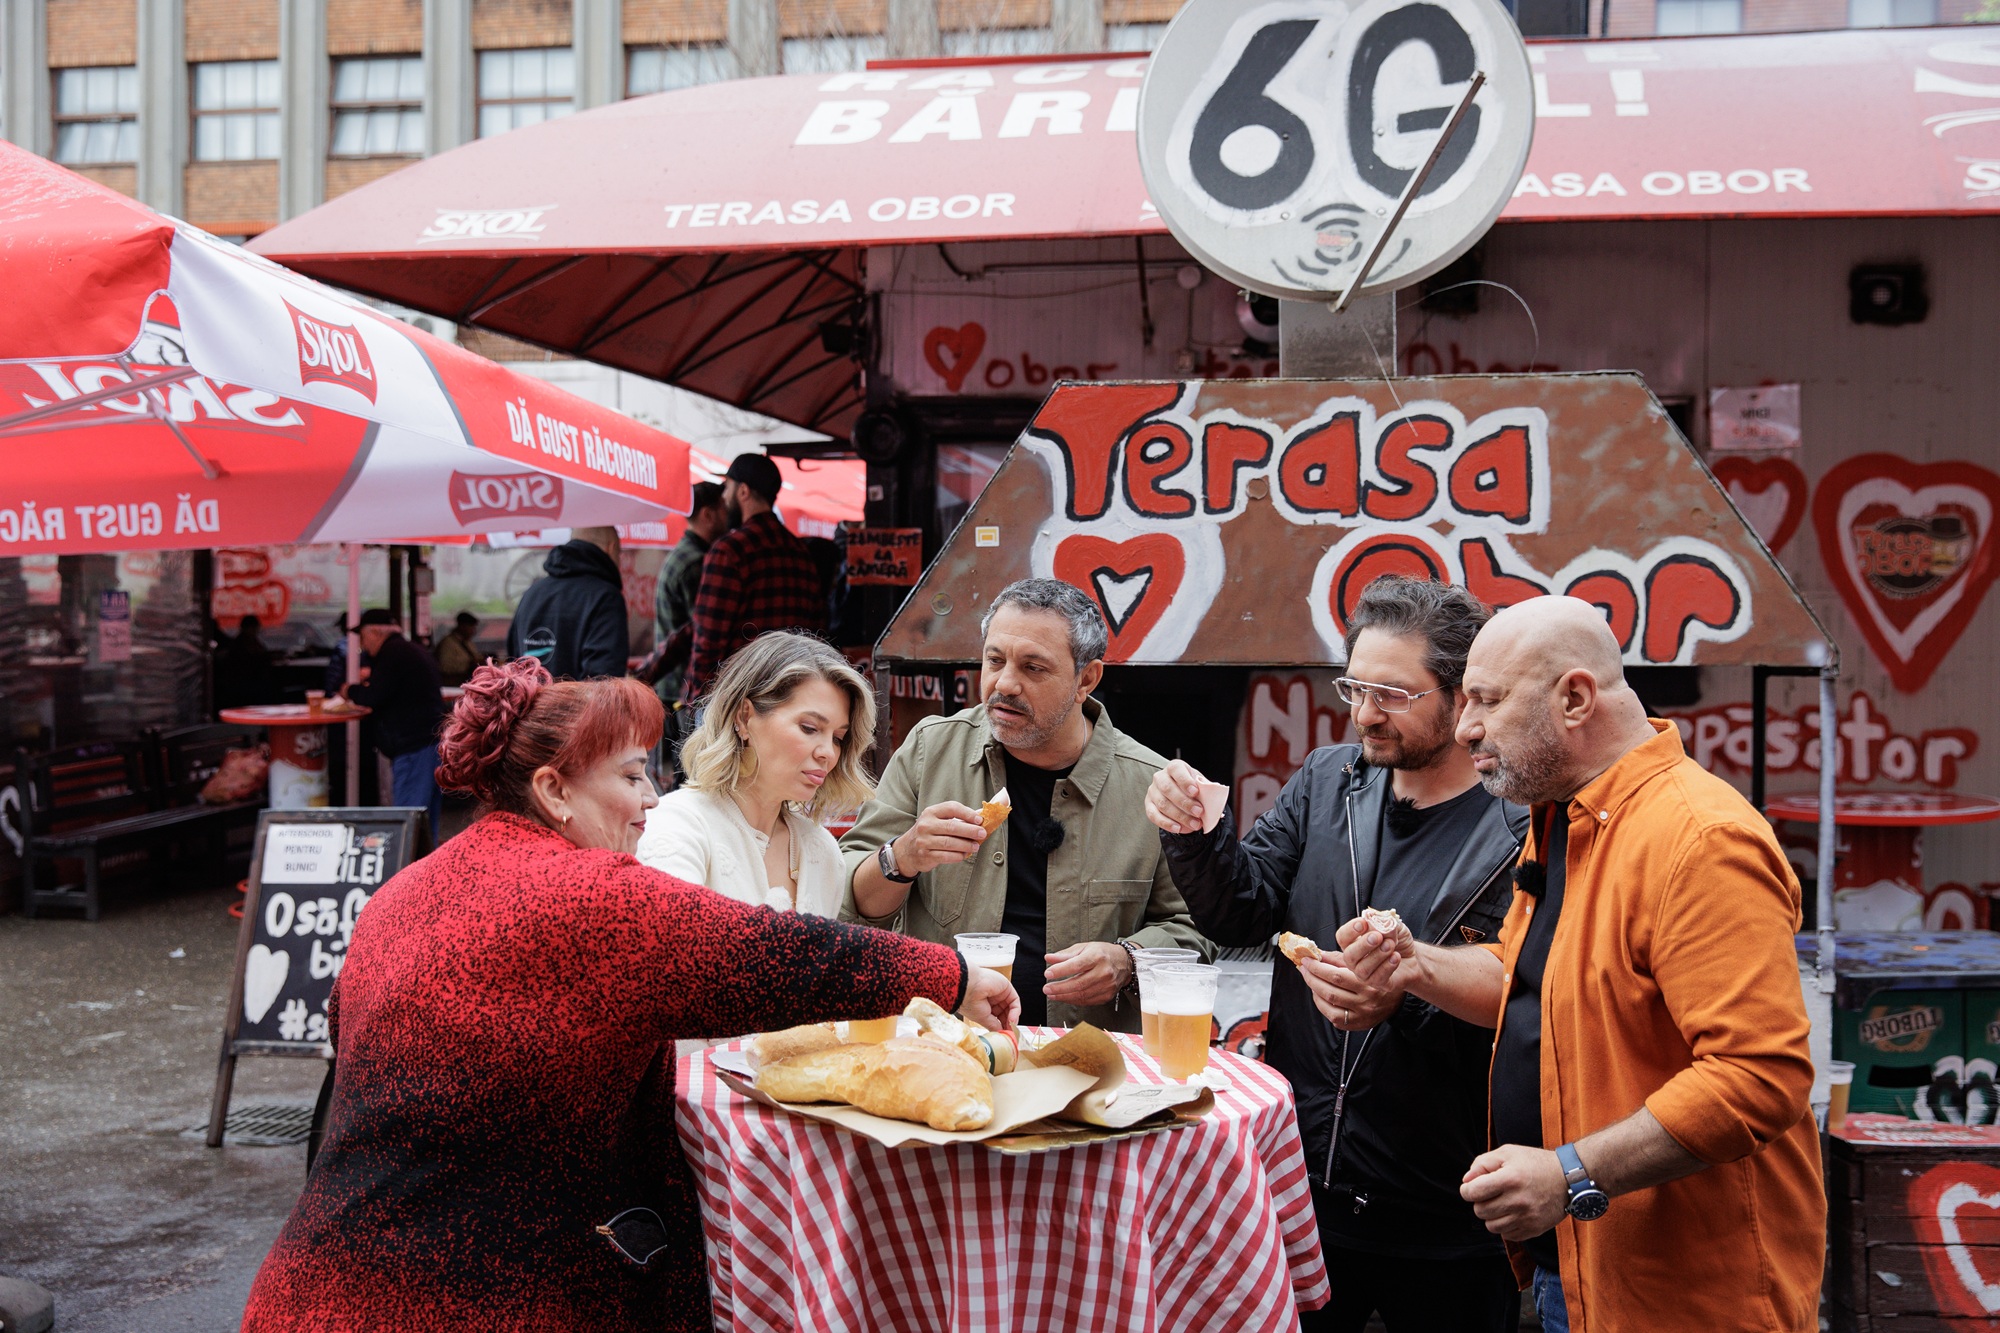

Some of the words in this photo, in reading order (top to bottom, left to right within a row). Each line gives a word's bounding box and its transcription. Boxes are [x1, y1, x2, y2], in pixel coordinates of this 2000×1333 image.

[1188, 4, 1482, 211] 6G
[421, 207, 551, 239] SKOL
[664, 199, 852, 229] TERASA
[867, 193, 1016, 223] OBOR
[1512, 172, 1628, 198] ASA
[1640, 168, 1813, 196] OBOR
[298, 314, 372, 380] SKOL
[505, 396, 537, 449] DĂ
[536, 413, 581, 464] GUST
[582, 426, 658, 490] RĂCORIRII
[1028, 382, 1534, 525] Terasa
[284, 844, 322, 855] PENTRU
[285, 862, 317, 872] BUNICI
[1862, 1008, 1938, 1042] TUBORG
